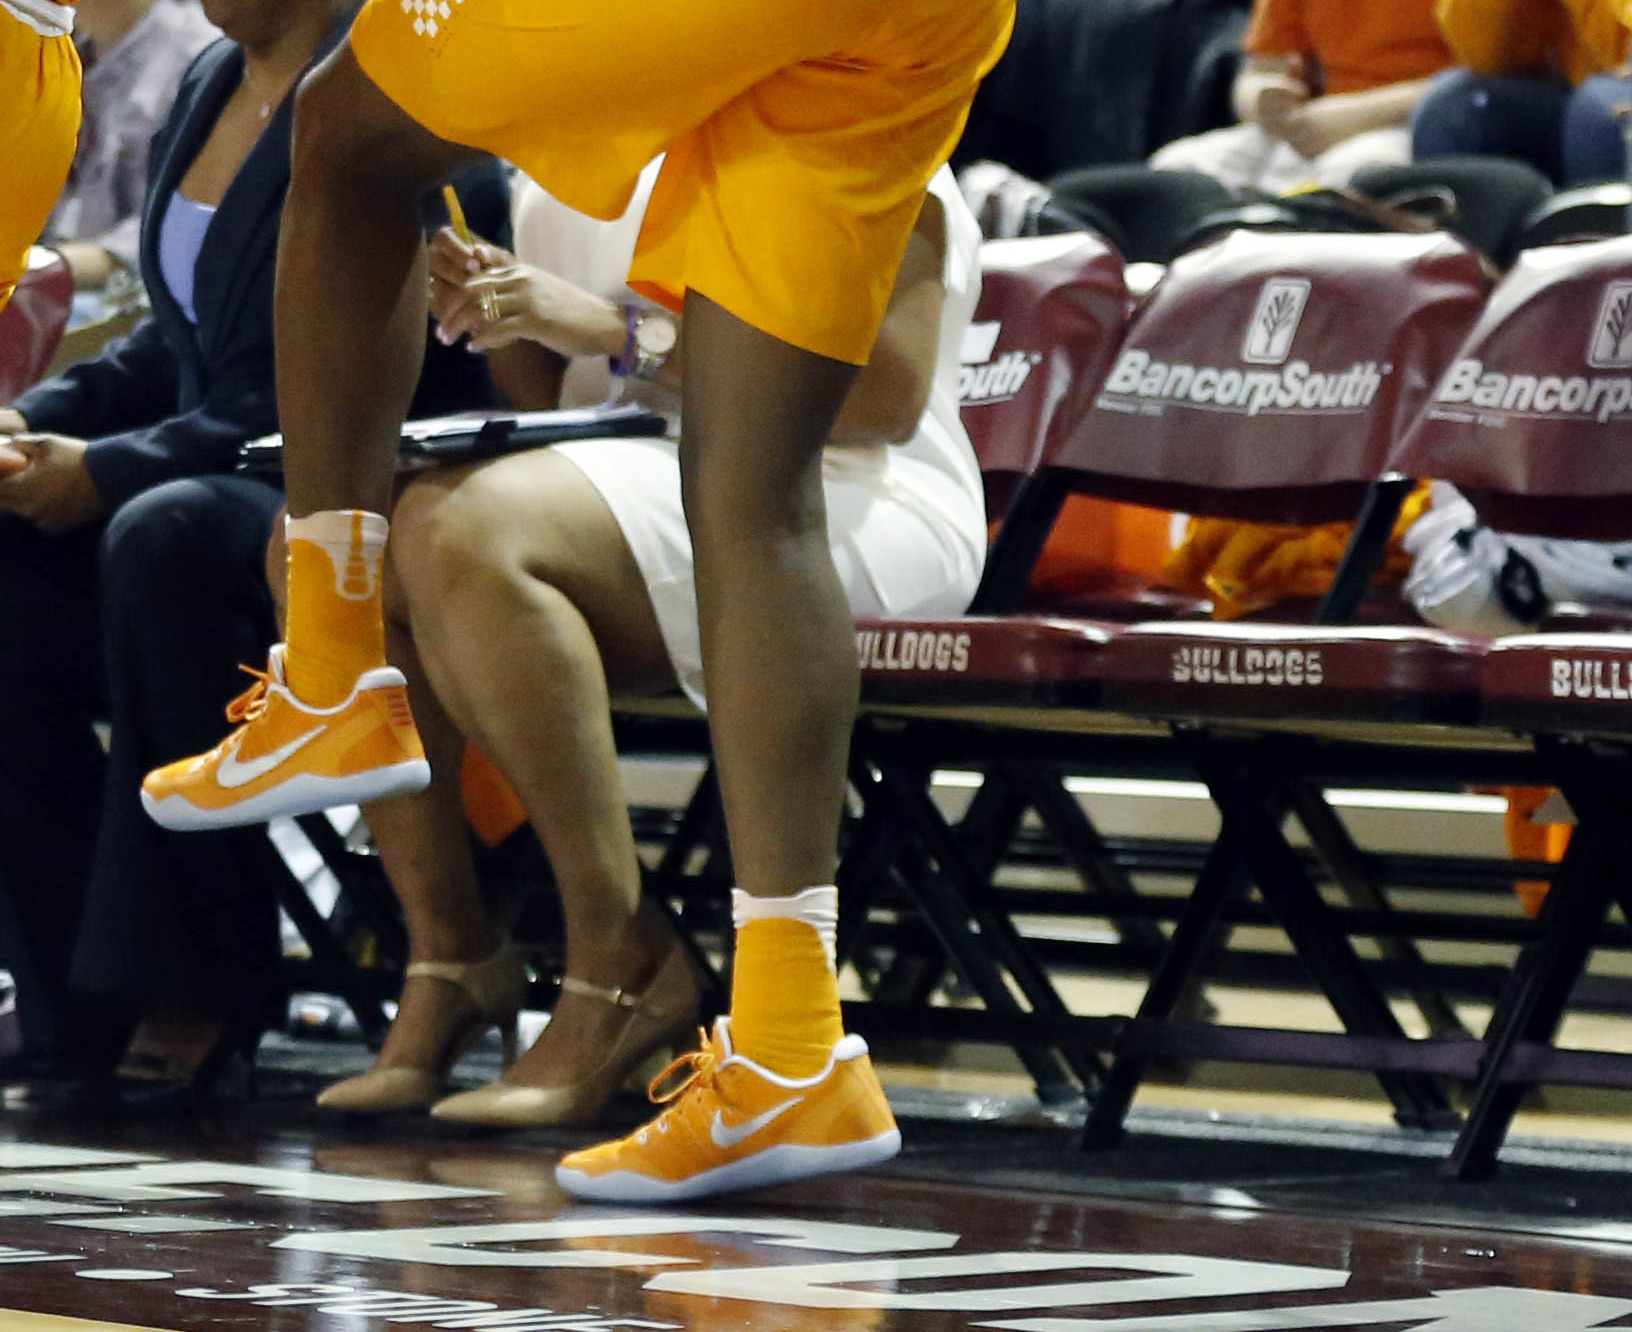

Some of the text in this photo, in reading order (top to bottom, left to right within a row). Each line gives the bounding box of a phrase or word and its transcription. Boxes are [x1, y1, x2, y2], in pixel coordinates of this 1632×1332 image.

[958, 350, 1032, 400] outh
[1105, 349, 1382, 416] BancorpSouth
[1438, 359, 1632, 424] Bancorp
[854, 630, 971, 672] ULLDOGS
[1173, 647, 1324, 686] BULLDOGS
[1551, 659, 1632, 700] BULL
